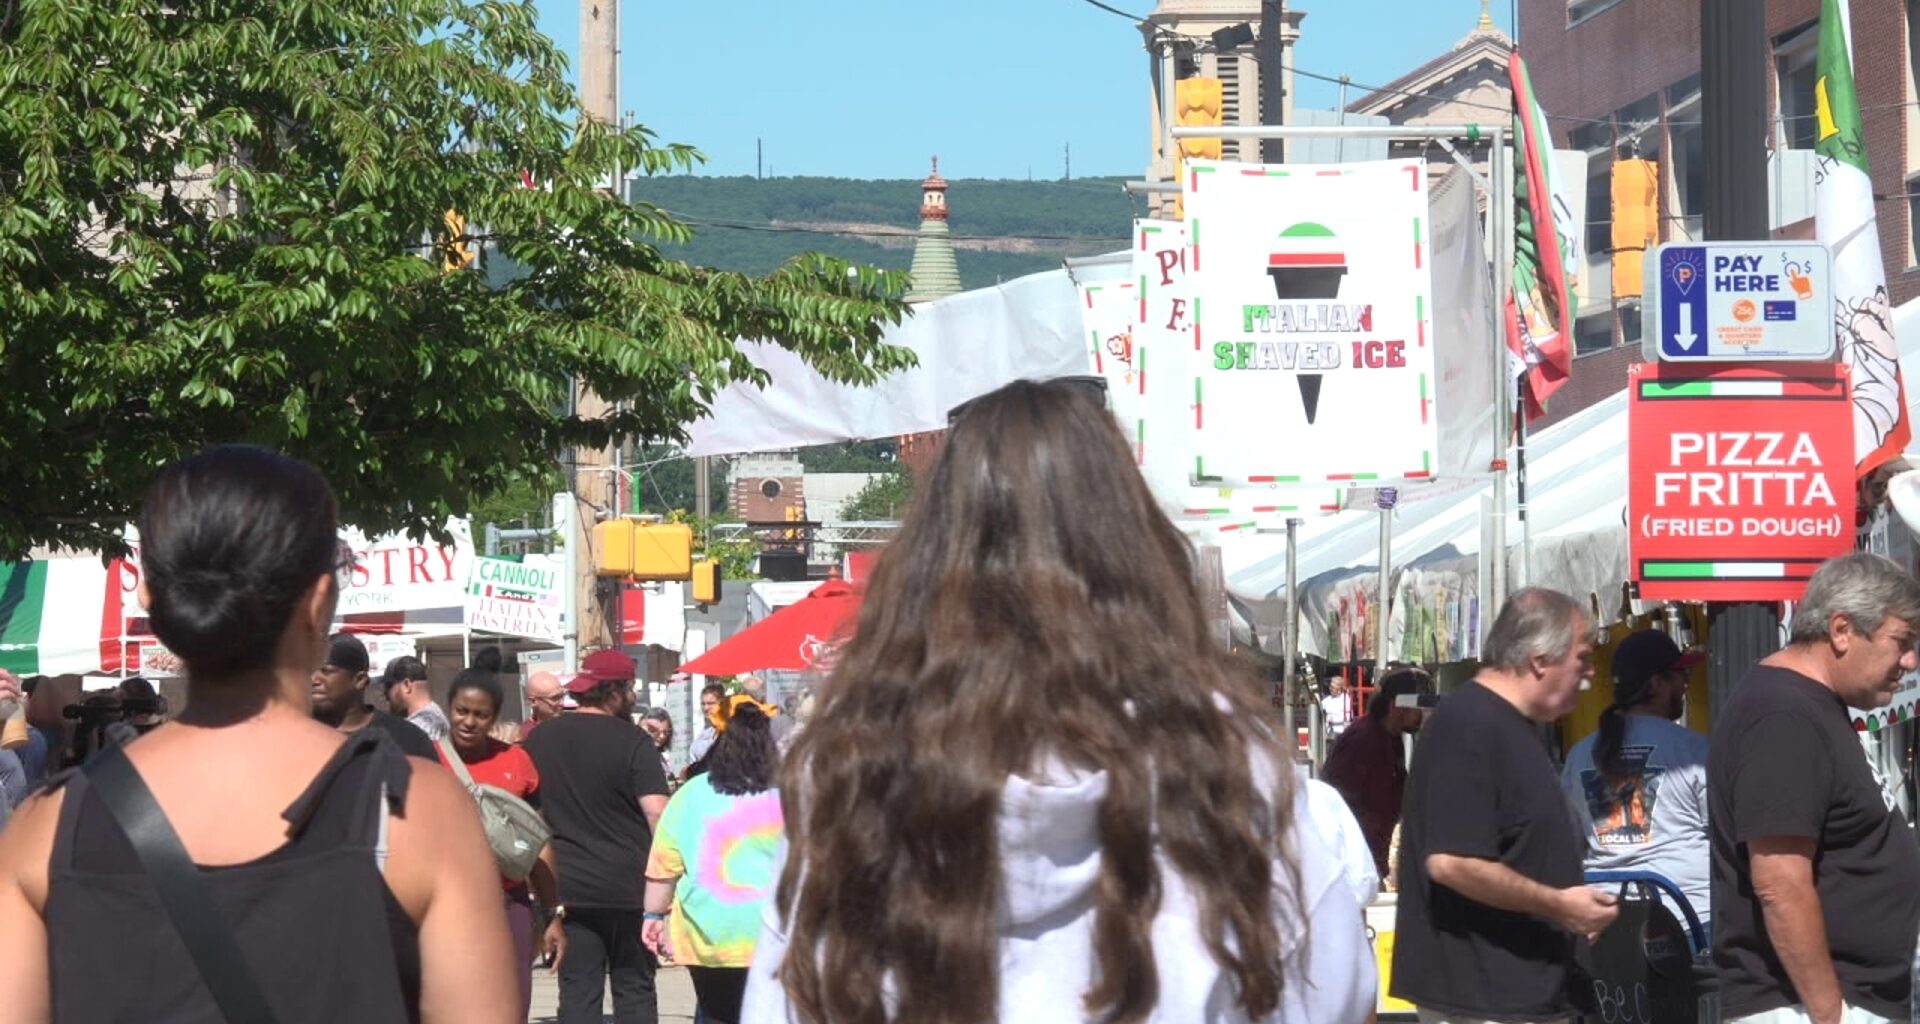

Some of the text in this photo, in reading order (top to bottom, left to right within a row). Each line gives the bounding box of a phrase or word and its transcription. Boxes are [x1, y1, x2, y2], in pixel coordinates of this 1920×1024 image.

[1714, 255, 1762, 273] PAY
[1714, 275, 1780, 292] HERE
[1242, 304, 1373, 333] ITALIAN
[1213, 339, 1407, 370] SHAVED ICE
[1670, 432, 1822, 467] PIZZA
[1655, 472, 1837, 506] FRITTA
[1641, 513, 1842, 538] (FRIED DOUGH)
[480, 560, 555, 589] CANNOLI
[1601, 834, 1630, 843] LOCAL
